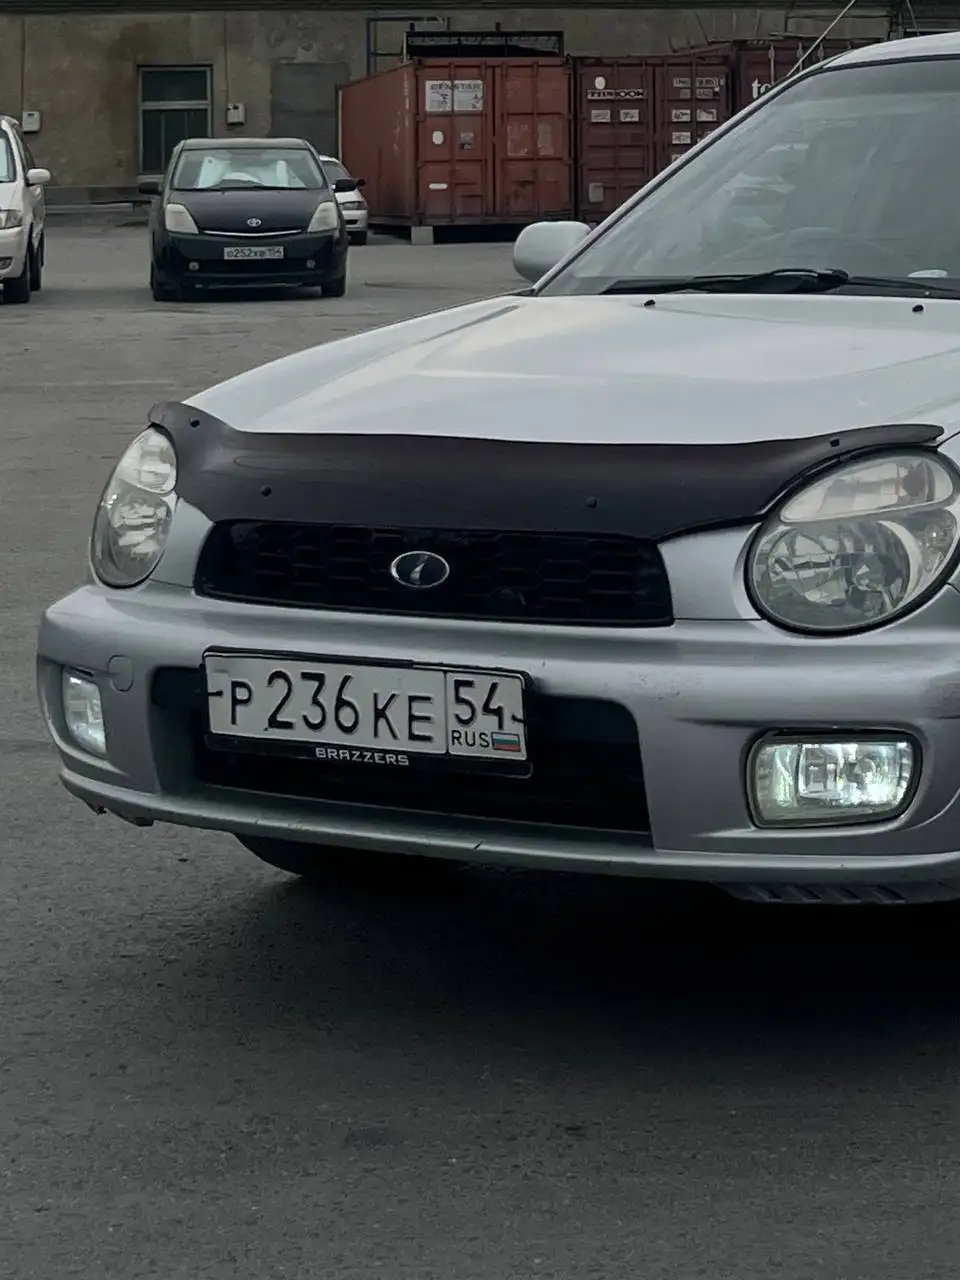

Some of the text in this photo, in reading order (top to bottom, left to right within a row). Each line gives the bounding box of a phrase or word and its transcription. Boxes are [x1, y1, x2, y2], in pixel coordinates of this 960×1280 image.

[453, 679, 505, 731] 54
[451, 730, 490, 748] RUS
[315, 747, 409, 766] BRAZZERS
